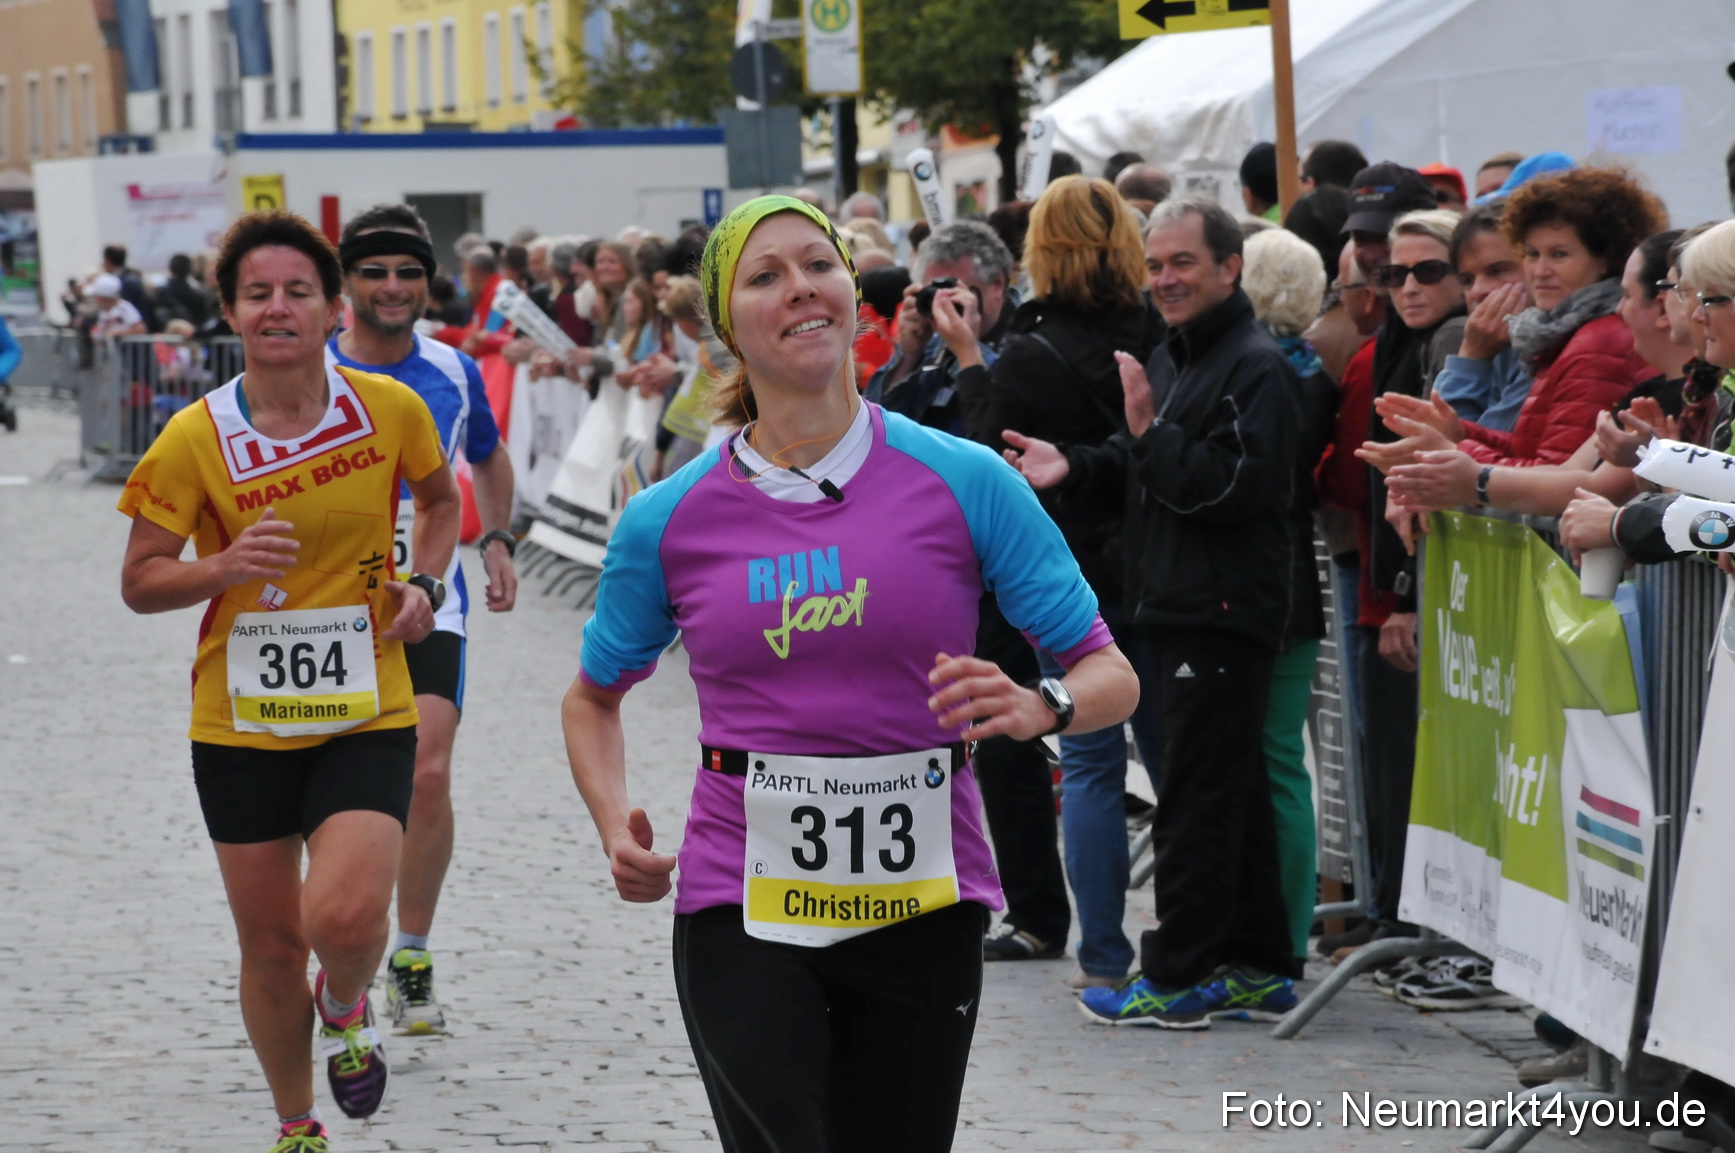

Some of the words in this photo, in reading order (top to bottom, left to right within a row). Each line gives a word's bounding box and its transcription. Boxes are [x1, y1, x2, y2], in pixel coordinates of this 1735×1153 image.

[235, 474, 305, 513] MAX
[311, 446, 386, 487] BÖGL
[748, 545, 843, 604] RUN
[231, 625, 278, 637] PARTL
[281, 621, 348, 636] Neumarkt
[763, 577, 873, 660] fast
[259, 640, 348, 690] 364
[260, 702, 349, 719] Marianne
[751, 772, 818, 795] PARTL
[823, 773, 918, 795] Neumarkt
[790, 803, 916, 874] 313
[755, 862, 763, 875] C
[784, 889, 921, 921] Christiane
